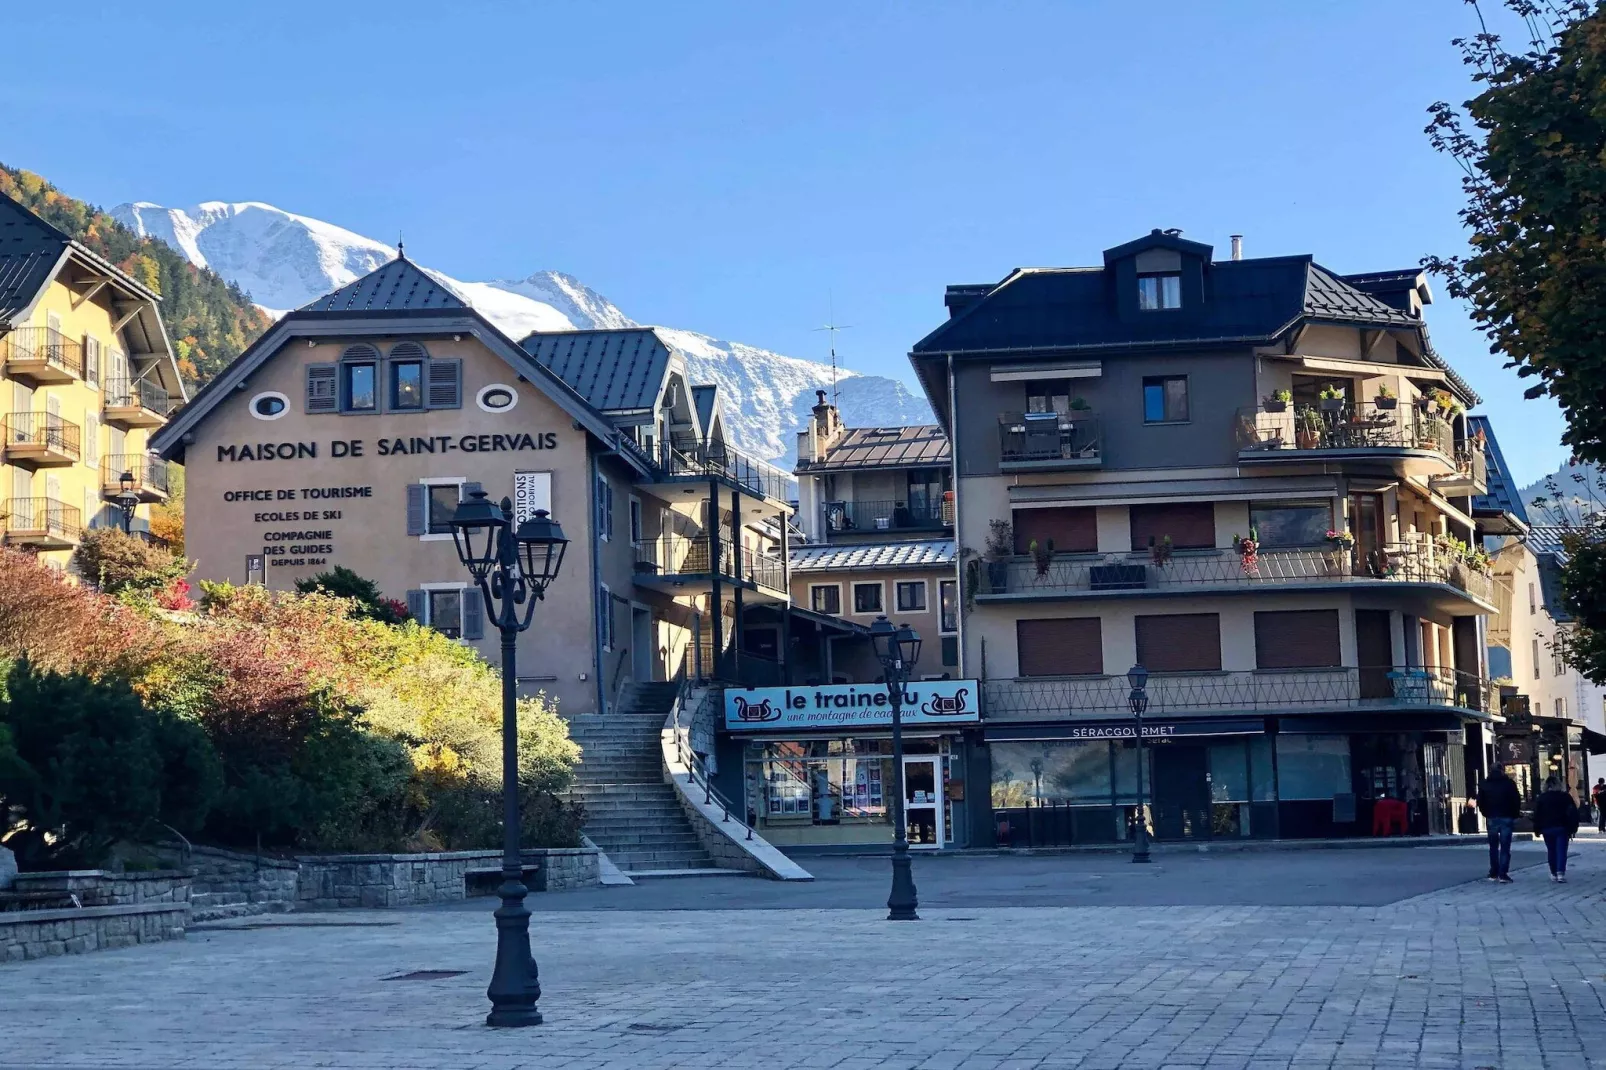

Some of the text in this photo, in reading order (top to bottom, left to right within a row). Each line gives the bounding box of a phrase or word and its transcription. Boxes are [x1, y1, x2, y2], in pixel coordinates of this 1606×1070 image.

[217, 432, 557, 462] MAISON DE SAINT-GERVAIS
[223, 486, 373, 502] OFFICE DE TOURISME
[254, 510, 342, 522] ECOLES DE SKI
[263, 530, 332, 541] COMPAGNIE
[263, 544, 333, 555] DES GUIDES
[271, 557, 326, 567] DEPUIS 1864
[785, 687, 919, 709] le traineu
[786, 706, 918, 723] une montagne de cadaux
